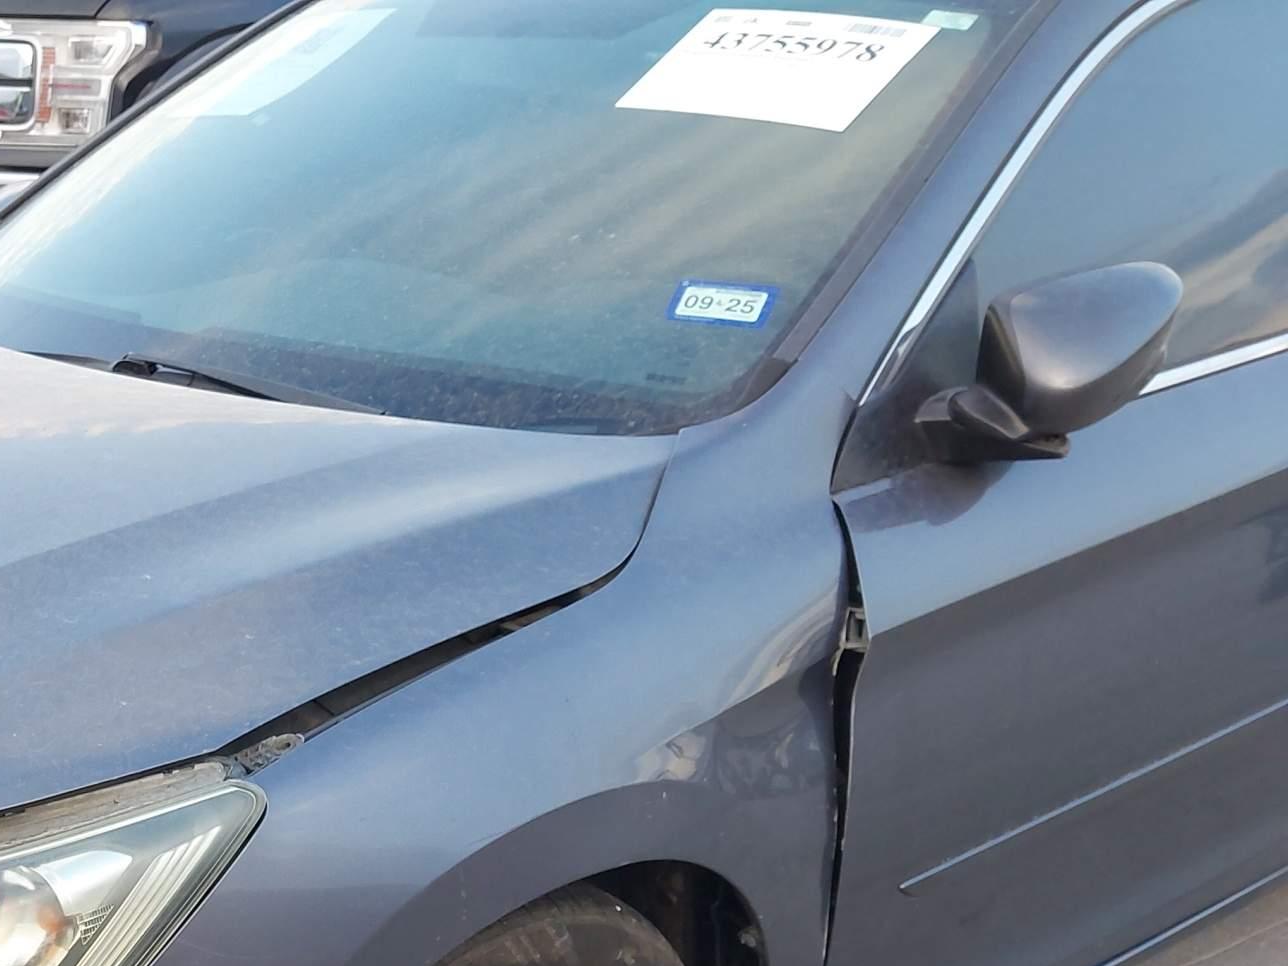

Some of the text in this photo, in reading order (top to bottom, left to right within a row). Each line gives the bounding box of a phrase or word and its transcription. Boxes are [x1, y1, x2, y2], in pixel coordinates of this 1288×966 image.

[704, 31, 885, 63] 43755978
[684, 294, 758, 315] 09 25
